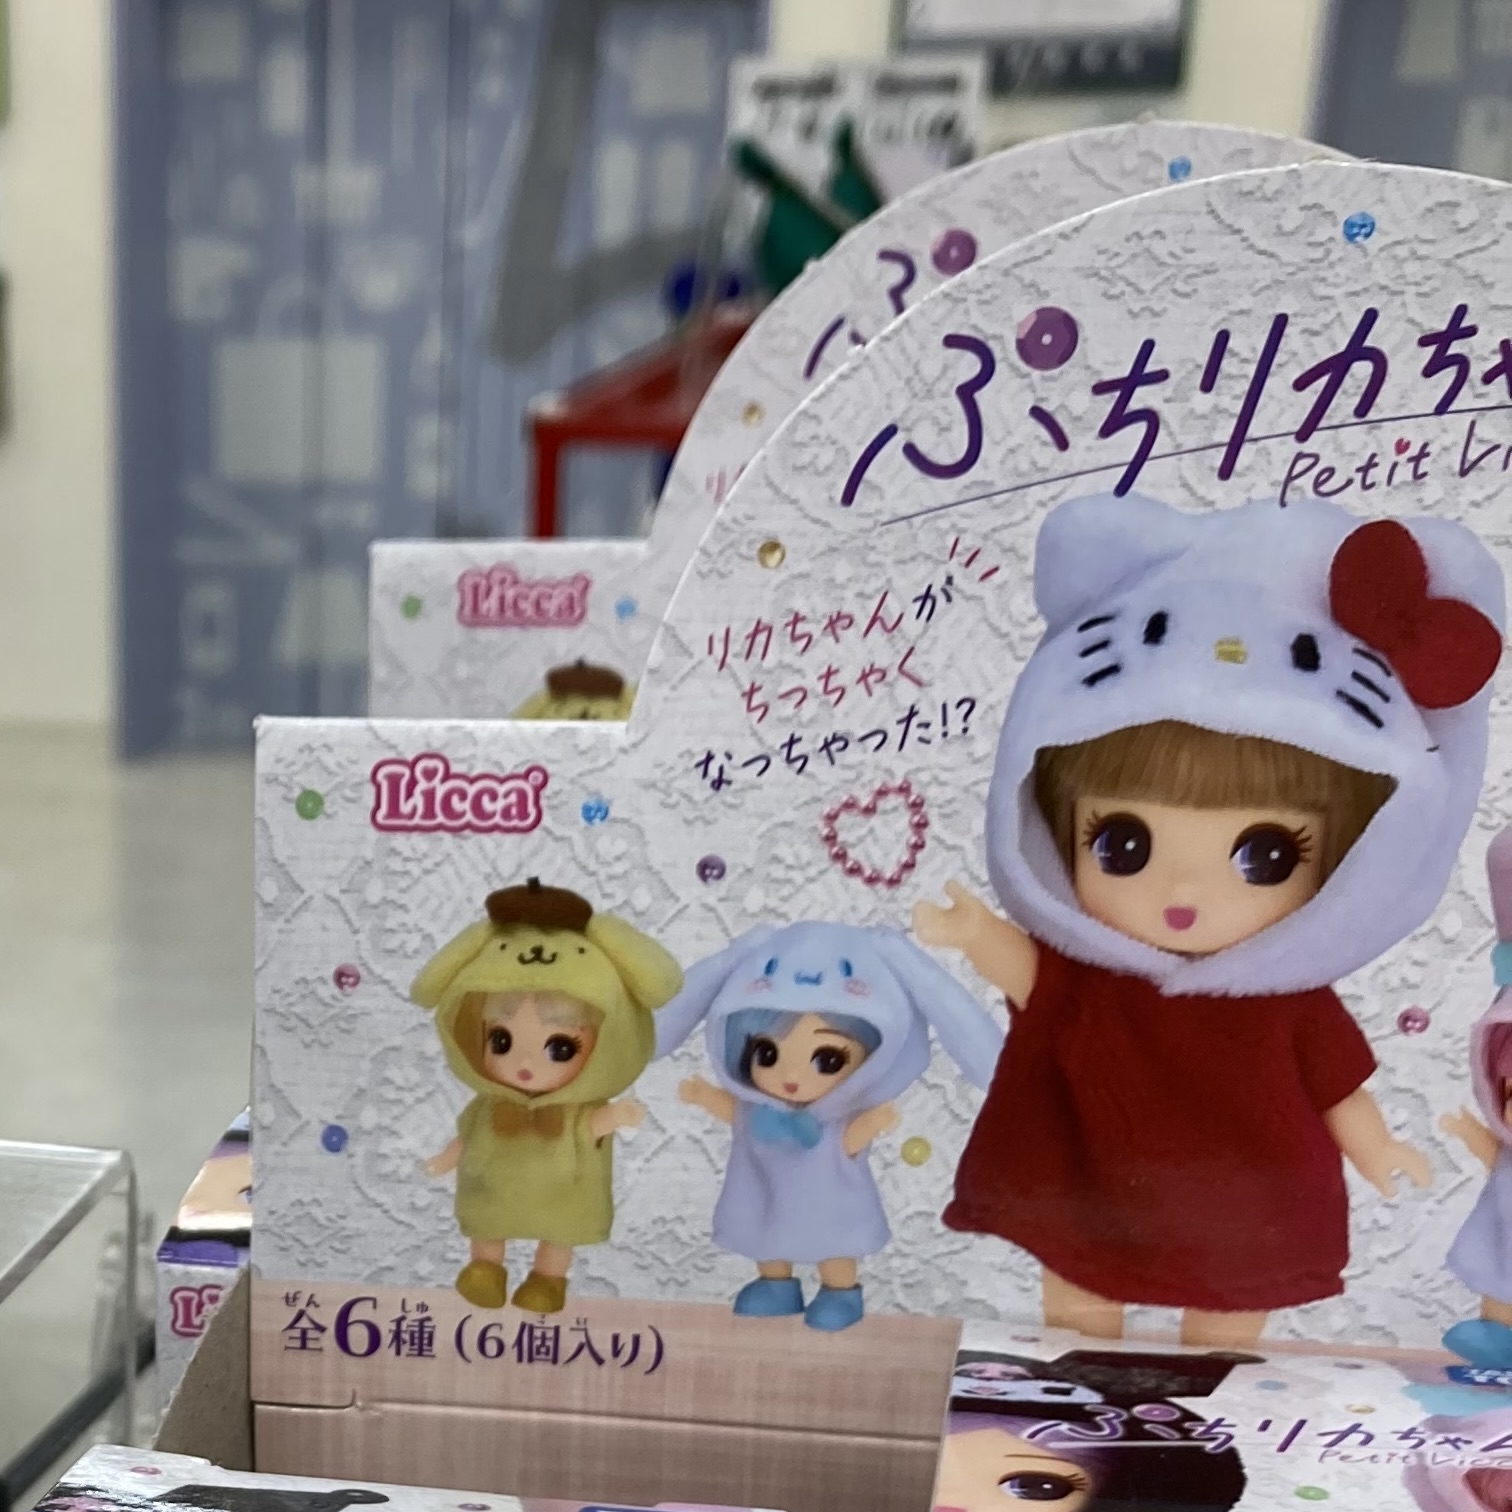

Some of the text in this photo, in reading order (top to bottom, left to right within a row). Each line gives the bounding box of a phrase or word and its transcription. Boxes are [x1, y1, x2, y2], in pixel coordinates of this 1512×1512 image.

[1279, 437, 1431, 508] Petit
[457, 561, 593, 629] Licca
[707, 575, 954, 673] リカちゃんが
[740, 645, 927, 724] ちっちゃく
[694, 697, 977, 792] なっちゃった!?
[371, 753, 549, 834] Licca
[1318, 1448, 1418, 1467] Petit
